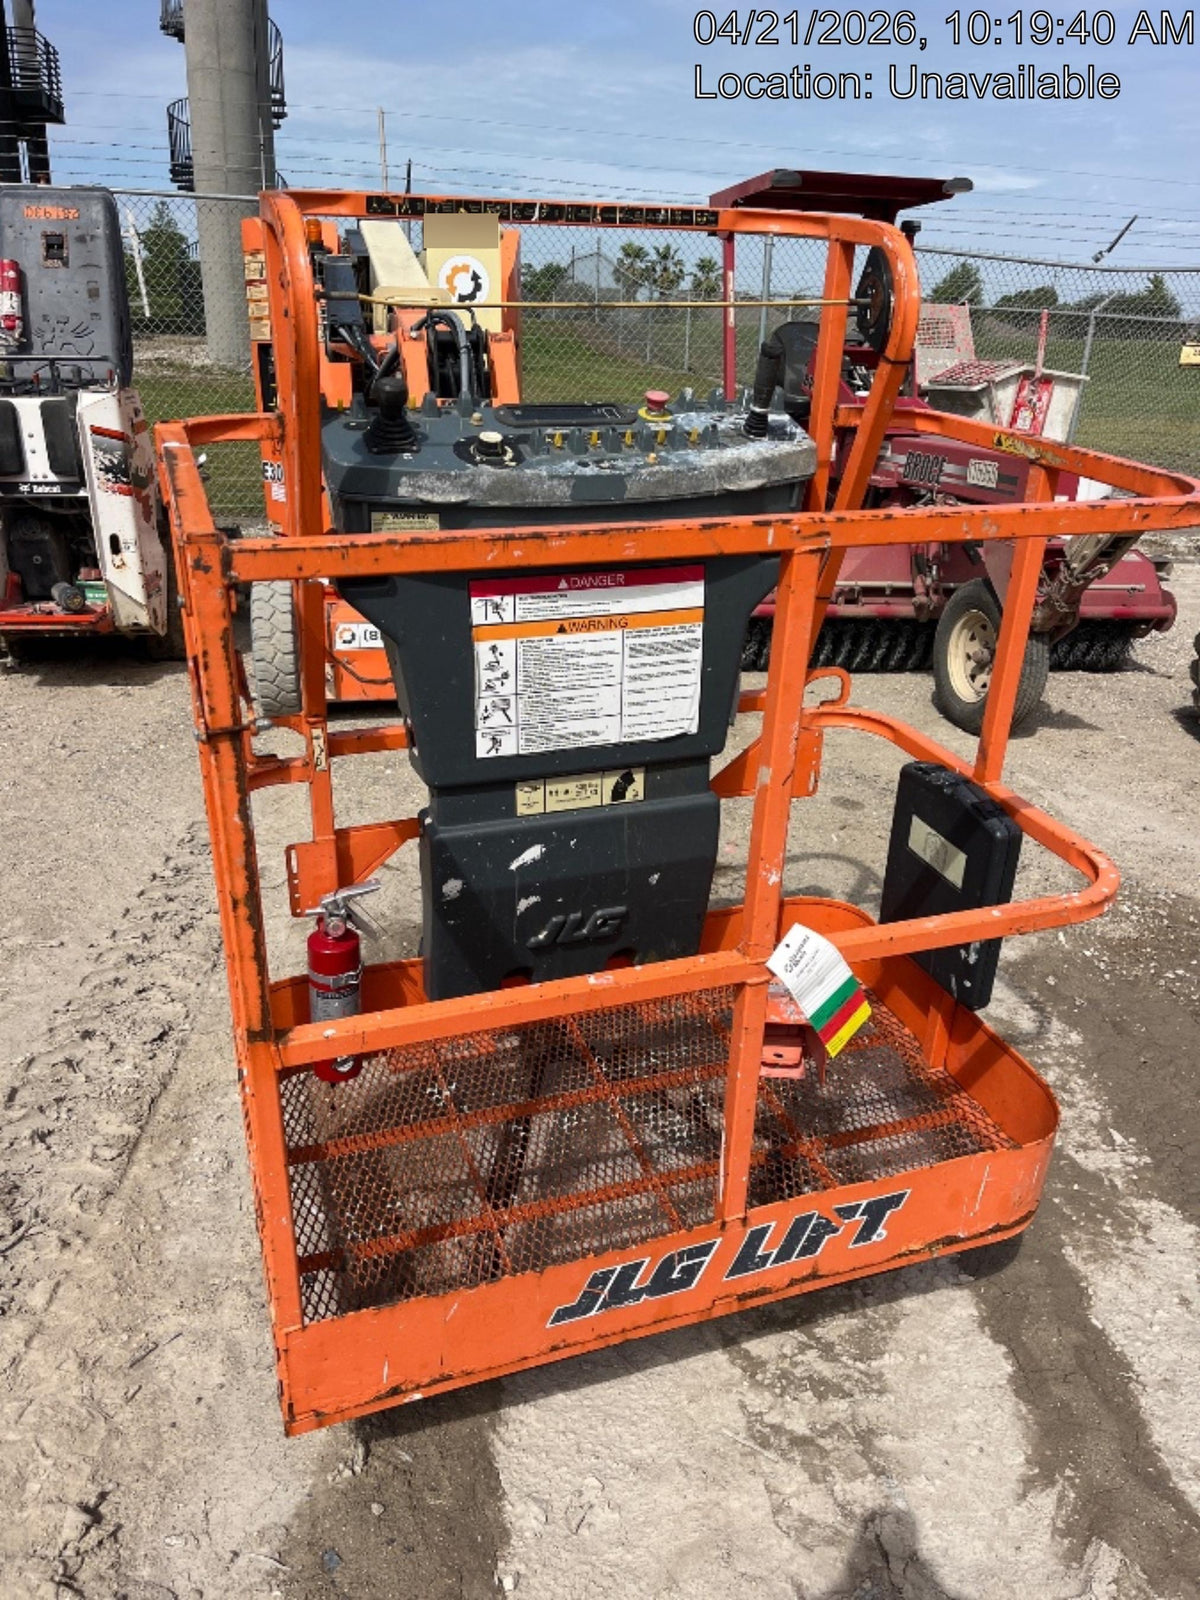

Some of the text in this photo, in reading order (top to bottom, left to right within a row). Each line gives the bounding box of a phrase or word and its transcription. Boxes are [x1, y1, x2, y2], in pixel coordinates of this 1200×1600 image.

[902, 450, 947, 485] BROCE
[570, 573, 625, 588] DANGER
[568, 616, 629, 632] WARNING
[526, 905, 627, 949] JLG
[546, 1188, 911, 1328] JLG LIFT
